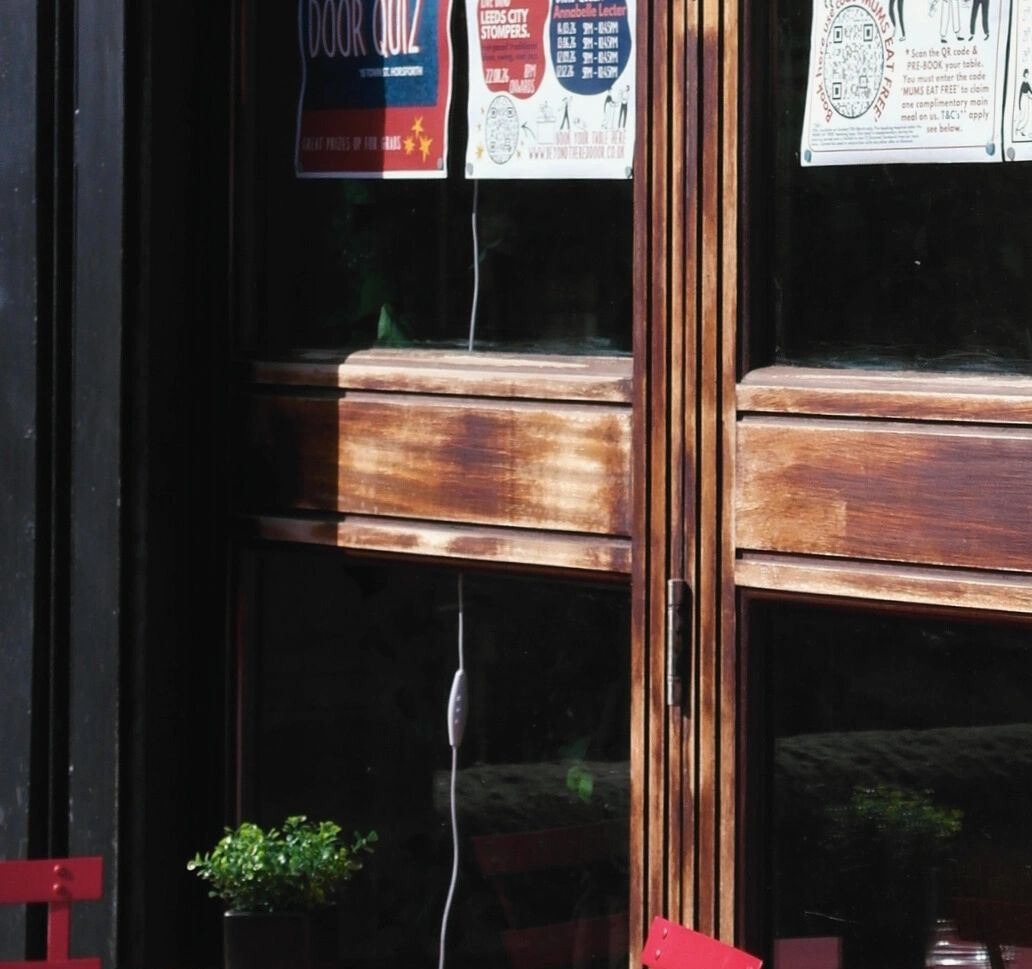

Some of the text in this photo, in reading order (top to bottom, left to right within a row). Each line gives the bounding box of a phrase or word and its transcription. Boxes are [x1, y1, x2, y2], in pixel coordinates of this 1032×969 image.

[480, 8, 529, 24] LEEDS CITY
[552, 3, 625, 19] Annabelle Lecter
[308, 0, 423, 58] DOOR QUIZ
[480, 23, 531, 40] STOMPERS.
[885, 37, 896, 73] EAT
[911, 48, 928, 58] Scan
[929, 48, 940, 57] the
[941, 46, 951, 58] QR
[953, 46, 971, 56] code
[907, 61, 944, 71] PRE-BOOK
[944, 62, 961, 71] your
[903, 71, 987, 83] You must enter the code
[926, 85, 939, 95] EAT
[969, 82, 990, 93] claim
[901, 97, 988, 111] one complimentary main
[901, 111, 918, 121] meal
[919, 113, 929, 121] on
[968, 107, 990, 121] apply
